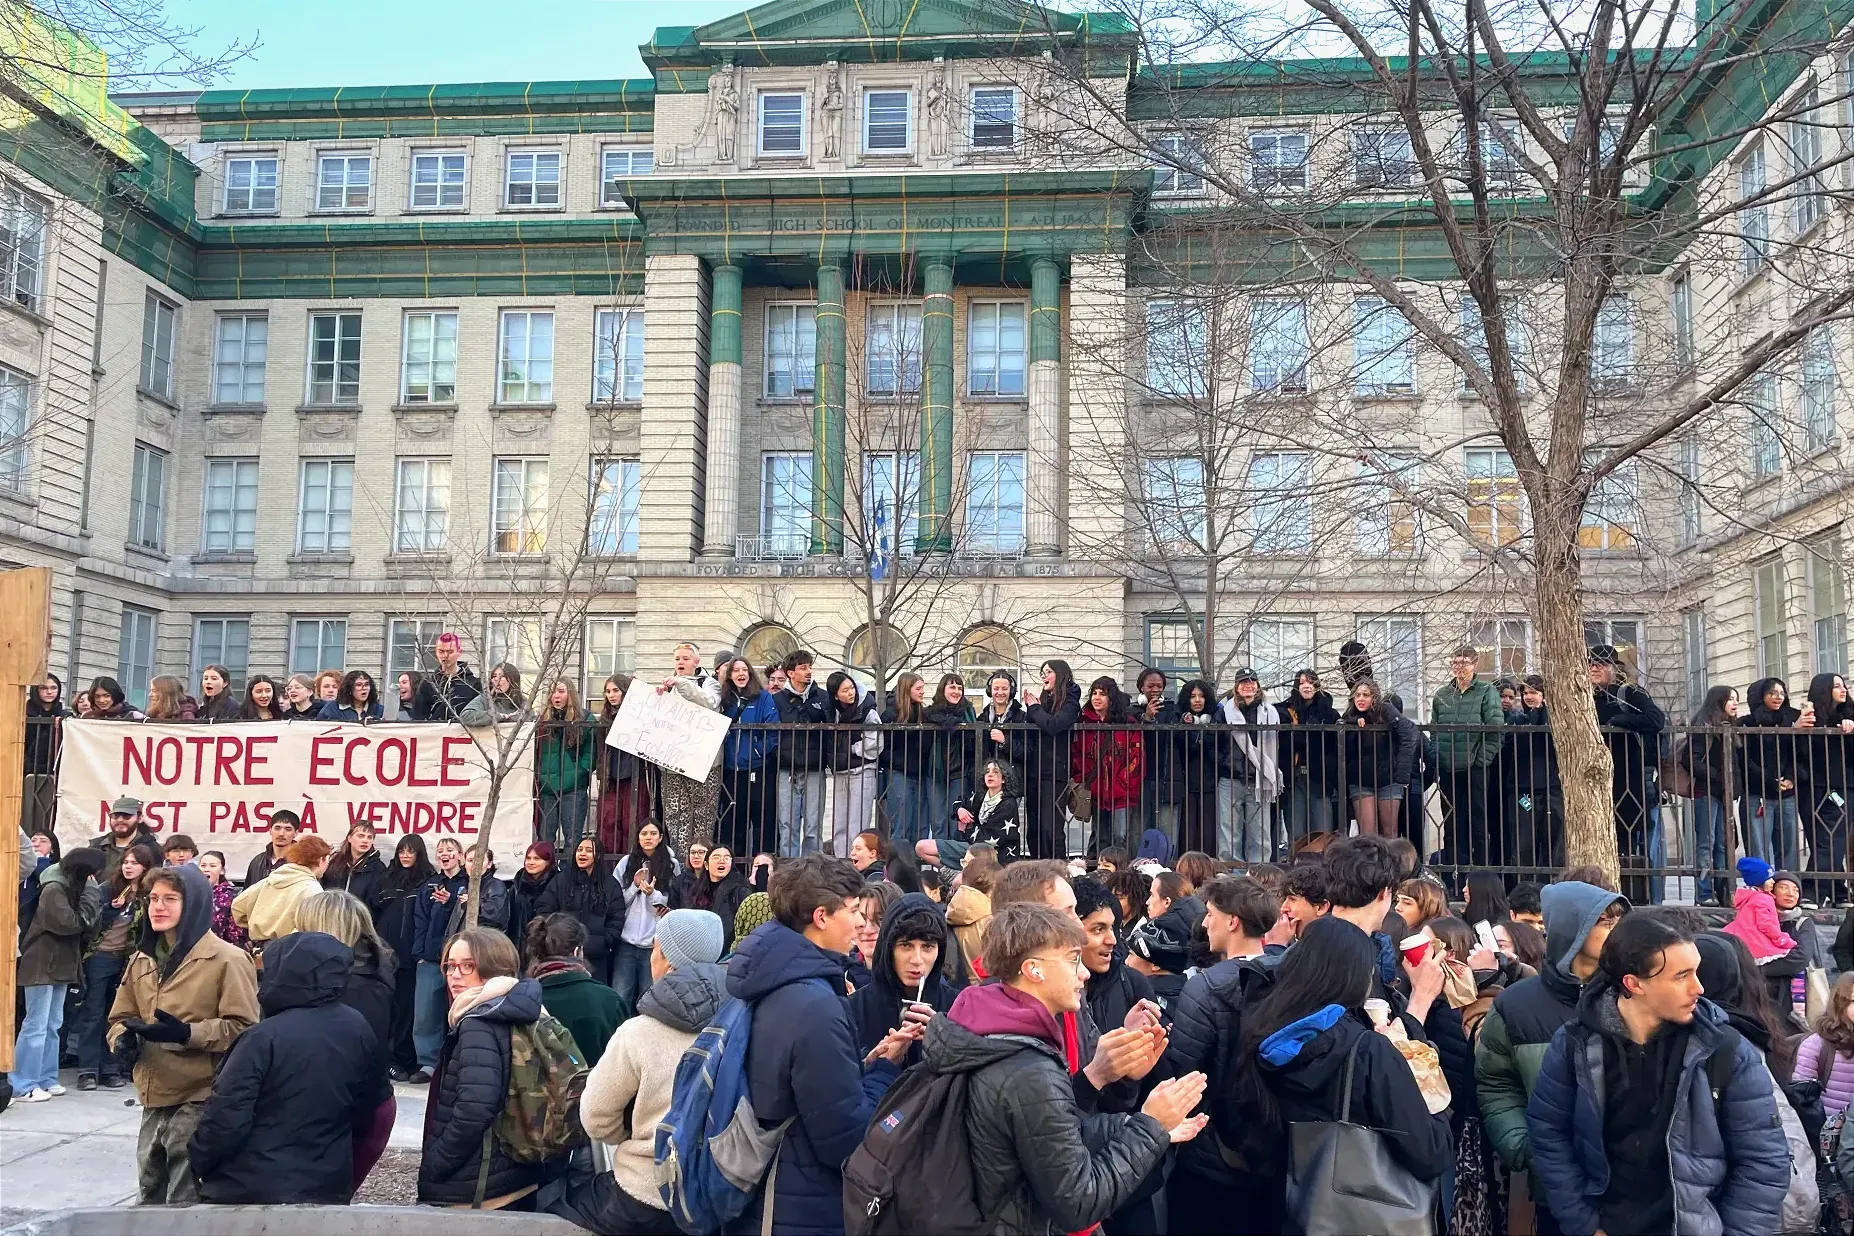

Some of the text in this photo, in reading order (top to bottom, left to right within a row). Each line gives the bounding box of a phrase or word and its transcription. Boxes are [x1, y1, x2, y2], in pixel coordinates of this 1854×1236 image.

[768, 219, 807, 230] HIGH
[816, 218, 877, 230] SCHOOL
[918, 216, 1004, 229] MONTREAL
[1035, 565, 1059, 575] 1875
[121, 726, 473, 786] NOTRE ÉCOLE
[210, 801, 275, 833] PAS
[300, 792, 318, 833] À
[347, 801, 482, 834] VENDRE
